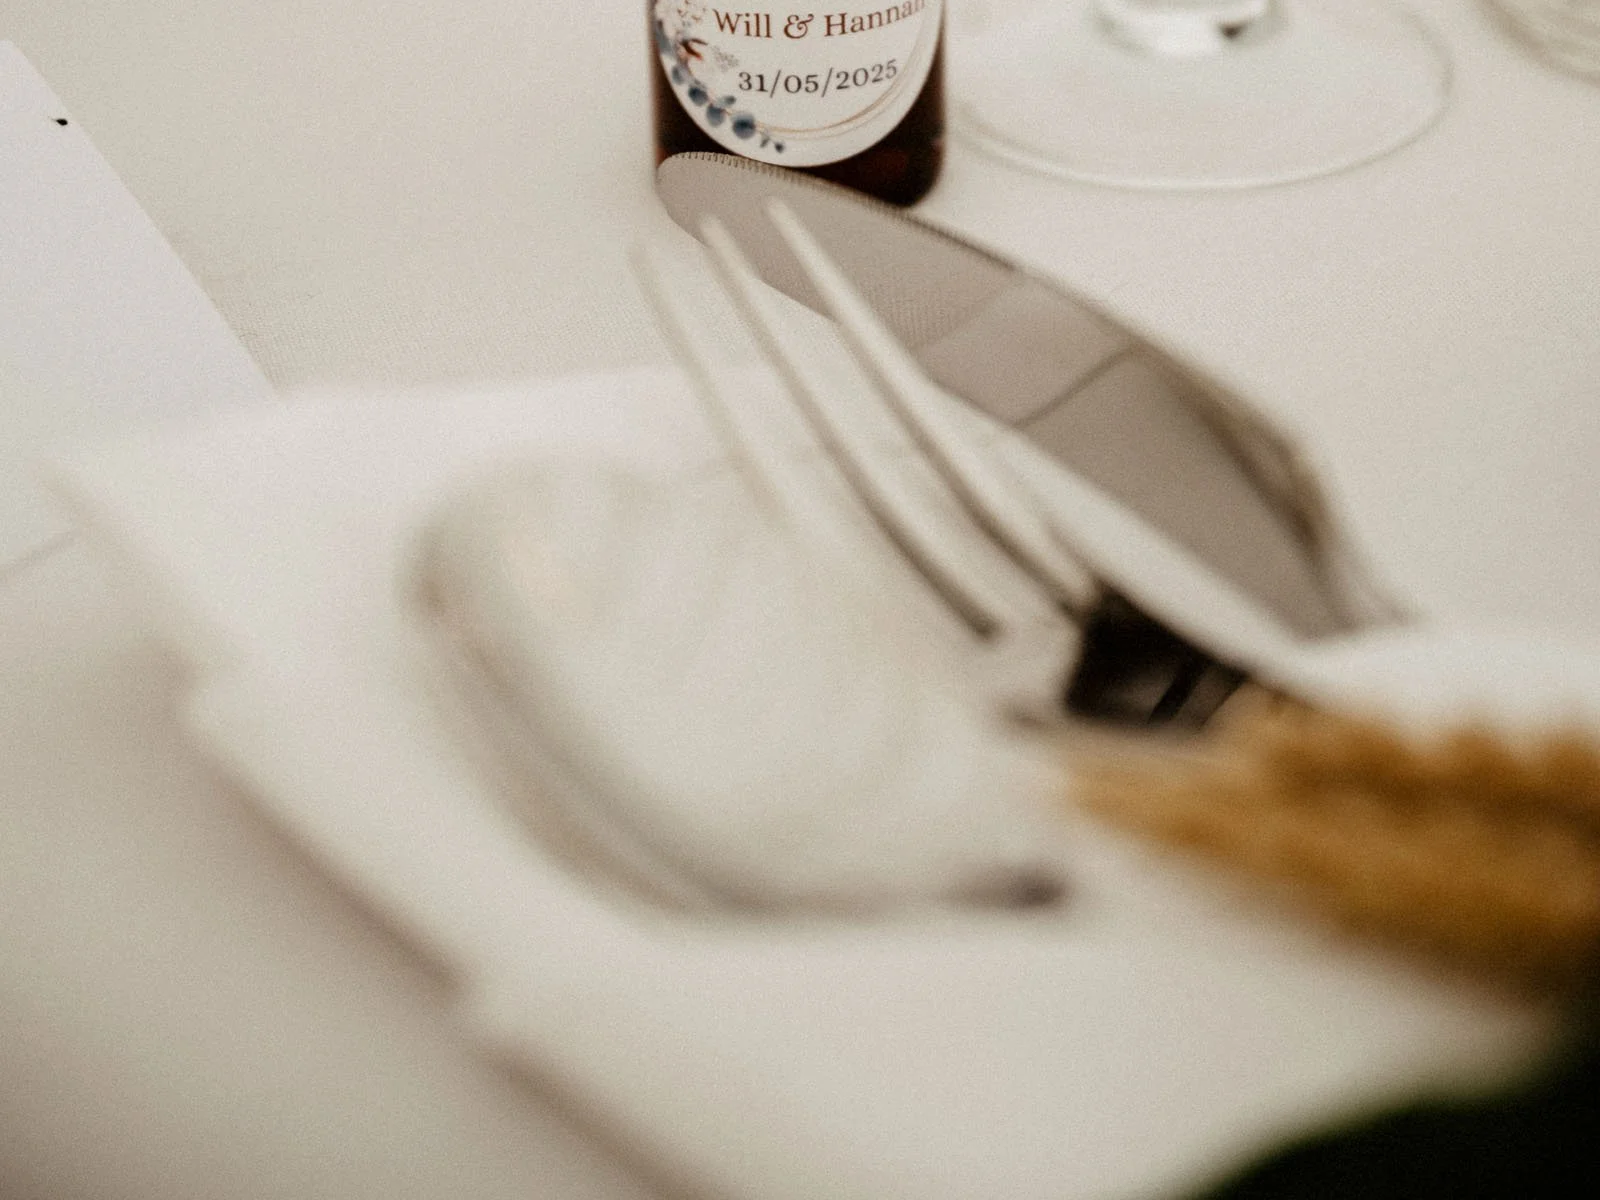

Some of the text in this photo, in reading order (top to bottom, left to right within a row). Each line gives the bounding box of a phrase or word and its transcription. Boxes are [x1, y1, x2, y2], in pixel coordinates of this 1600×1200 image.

[712, 9, 772, 39] Will
[784, 14, 814, 39] &
[739, 59, 899, 98] 31/05/2025
